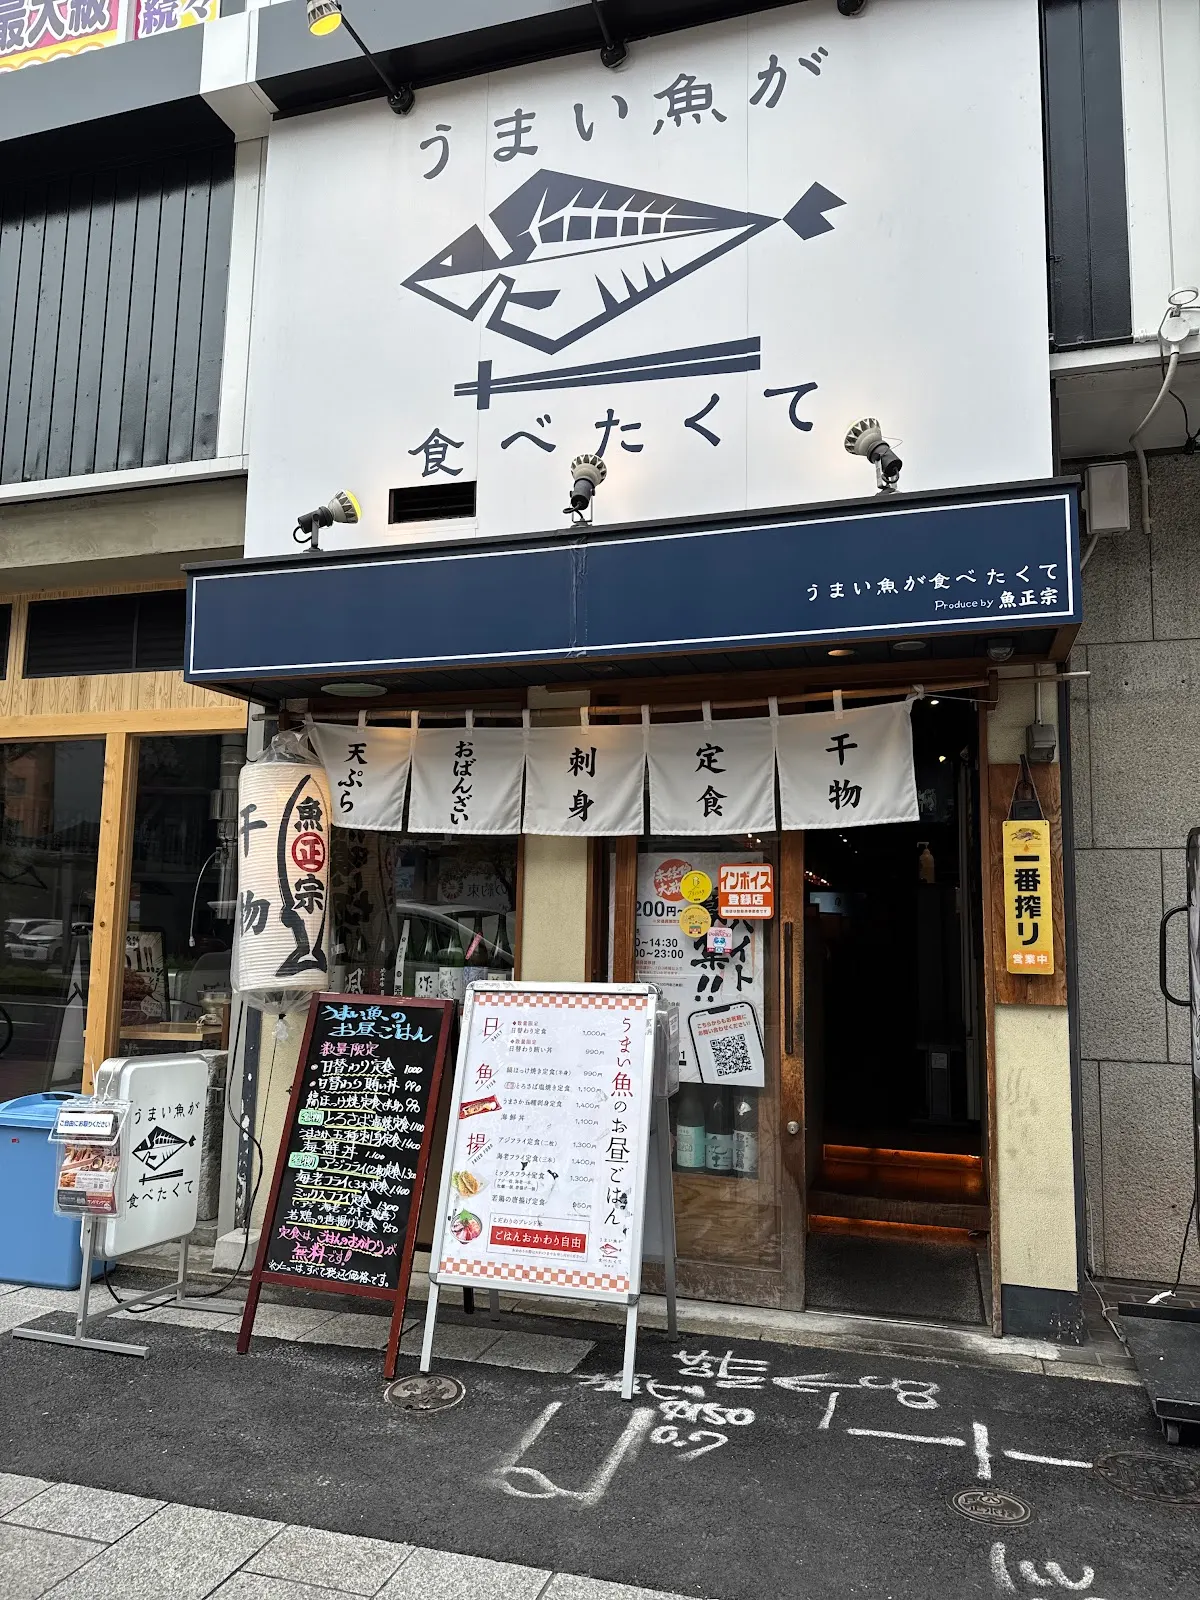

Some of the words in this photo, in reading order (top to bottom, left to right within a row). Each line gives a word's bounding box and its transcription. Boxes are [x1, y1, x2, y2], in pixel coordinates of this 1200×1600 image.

[419, 46, 829, 180] うまい魚が
[408, 381, 820, 477] 食べたくて
[806, 562, 1058, 602] うまい魚が食べたくて
[934, 600, 978, 611] Produce
[980, 599, 994, 609] by
[998, 587, 1058, 609] 魚正宗
[337, 742, 368, 813] 天ぷら
[449, 740, 475, 826] おばんざい
[567, 746, 598, 820] 刺身
[694, 742, 729, 817] 定食
[826, 732, 863, 811] 干物
[293, 795, 326, 915] 魚正宗
[720, 871, 772, 890] インボイス
[728, 893, 764, 905] 登録店
[1014, 855, 1041, 946] 一番搾り
[1012, 953, 1048, 964] 営業中
[321, 1005, 407, 1023] うまい魚の
[328, 1022, 433, 1043] お昼ごはん
[511, 1027, 547, 1035] 日替わり定食
[320, 1041, 380, 1058] 数量限定
[320, 1057, 396, 1075] 日替わり定食
[134, 1101, 201, 1125] うまい魚が
[501, 1113, 525, 1121] 海鮮丼
[604, 1017, 634, 1226] うまい魚のお昼ごはん
[300, 1140, 359, 1160] 海鮮丼
[126, 1180, 194, 1210] 食べたくて
[495, 1230, 581, 1249] ごはんおかわり自由
